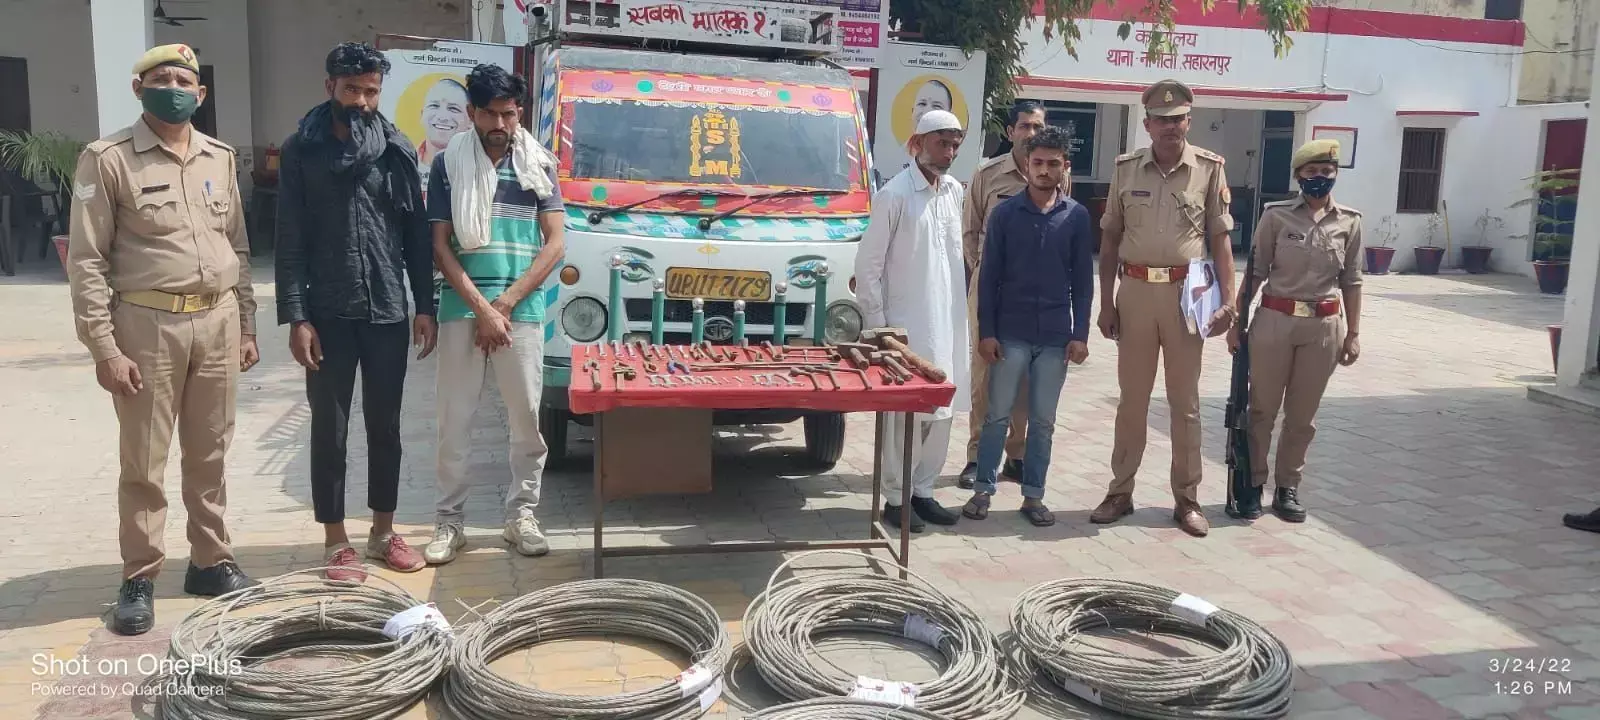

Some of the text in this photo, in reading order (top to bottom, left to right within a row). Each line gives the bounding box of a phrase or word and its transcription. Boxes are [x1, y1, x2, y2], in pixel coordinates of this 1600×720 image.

[1182, 53, 1232, 75] सहारनपुर
[706, 129, 725, 144] S
[704, 160, 729, 175] M
